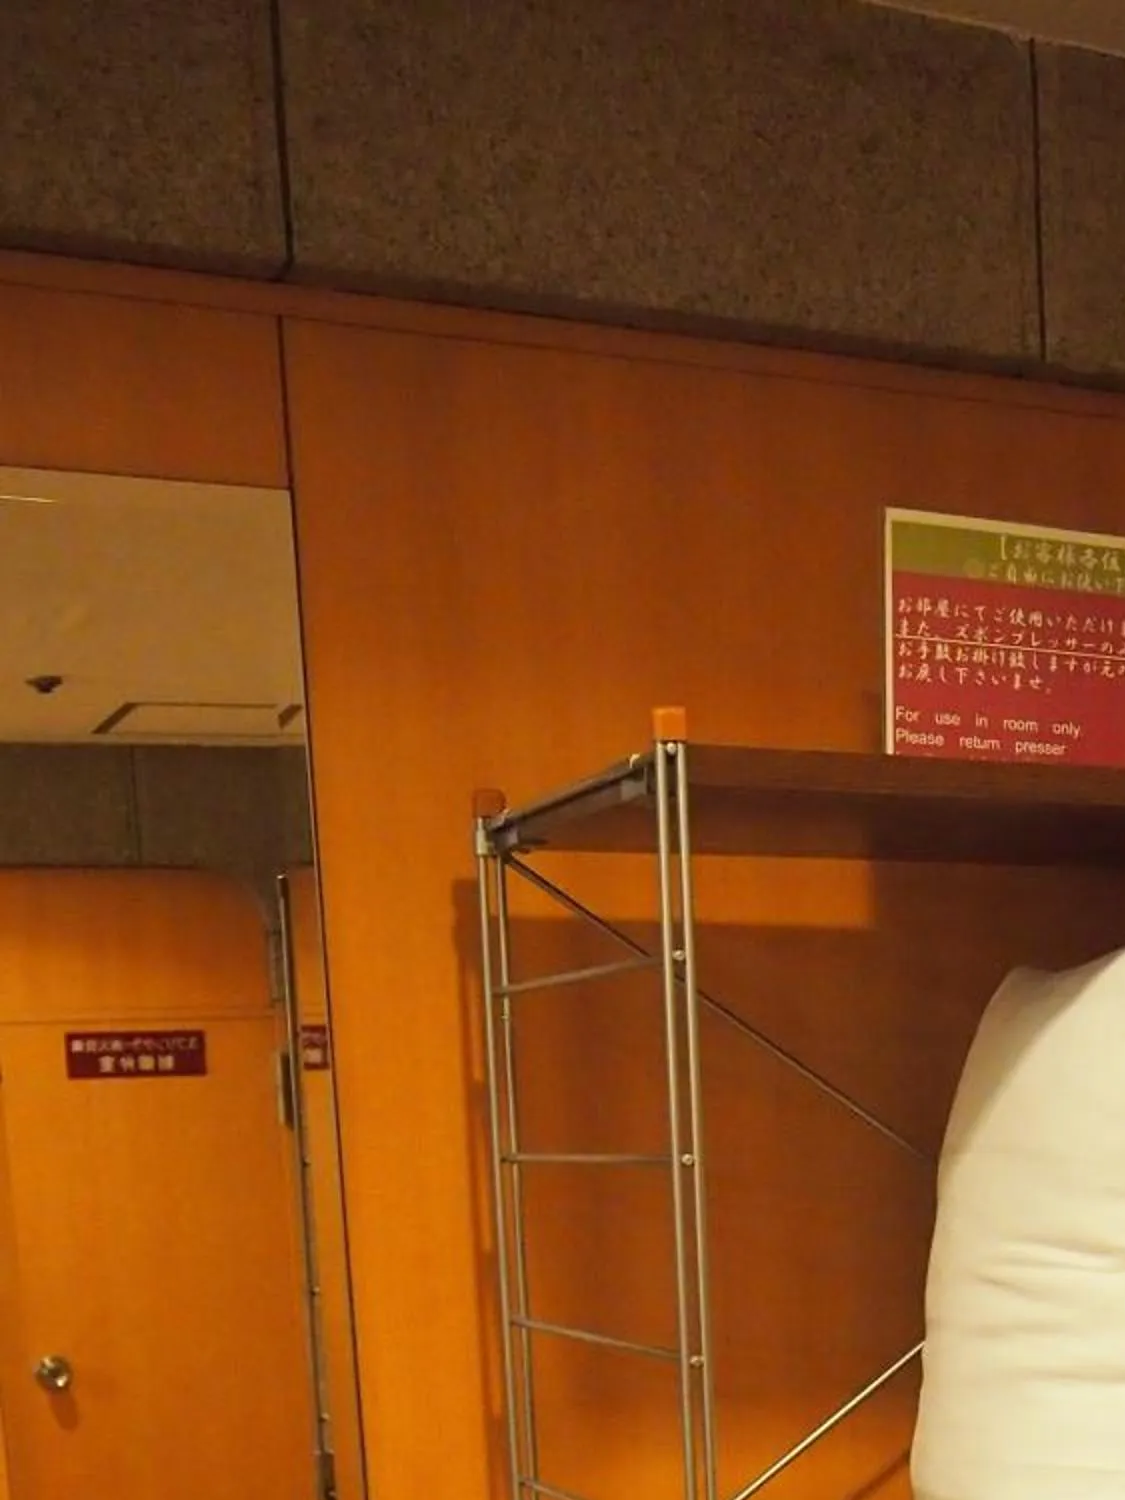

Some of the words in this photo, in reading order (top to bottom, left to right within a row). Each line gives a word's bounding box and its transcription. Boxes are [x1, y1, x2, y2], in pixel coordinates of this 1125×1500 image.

[895, 705, 919, 723] For
[935, 712, 961, 726] use
[975, 713, 989, 729] in
[1003, 718, 1038, 734] room
[895, 727, 945, 748] Please
[959, 735, 1001, 751] return
[1015, 739, 1067, 757] presser
